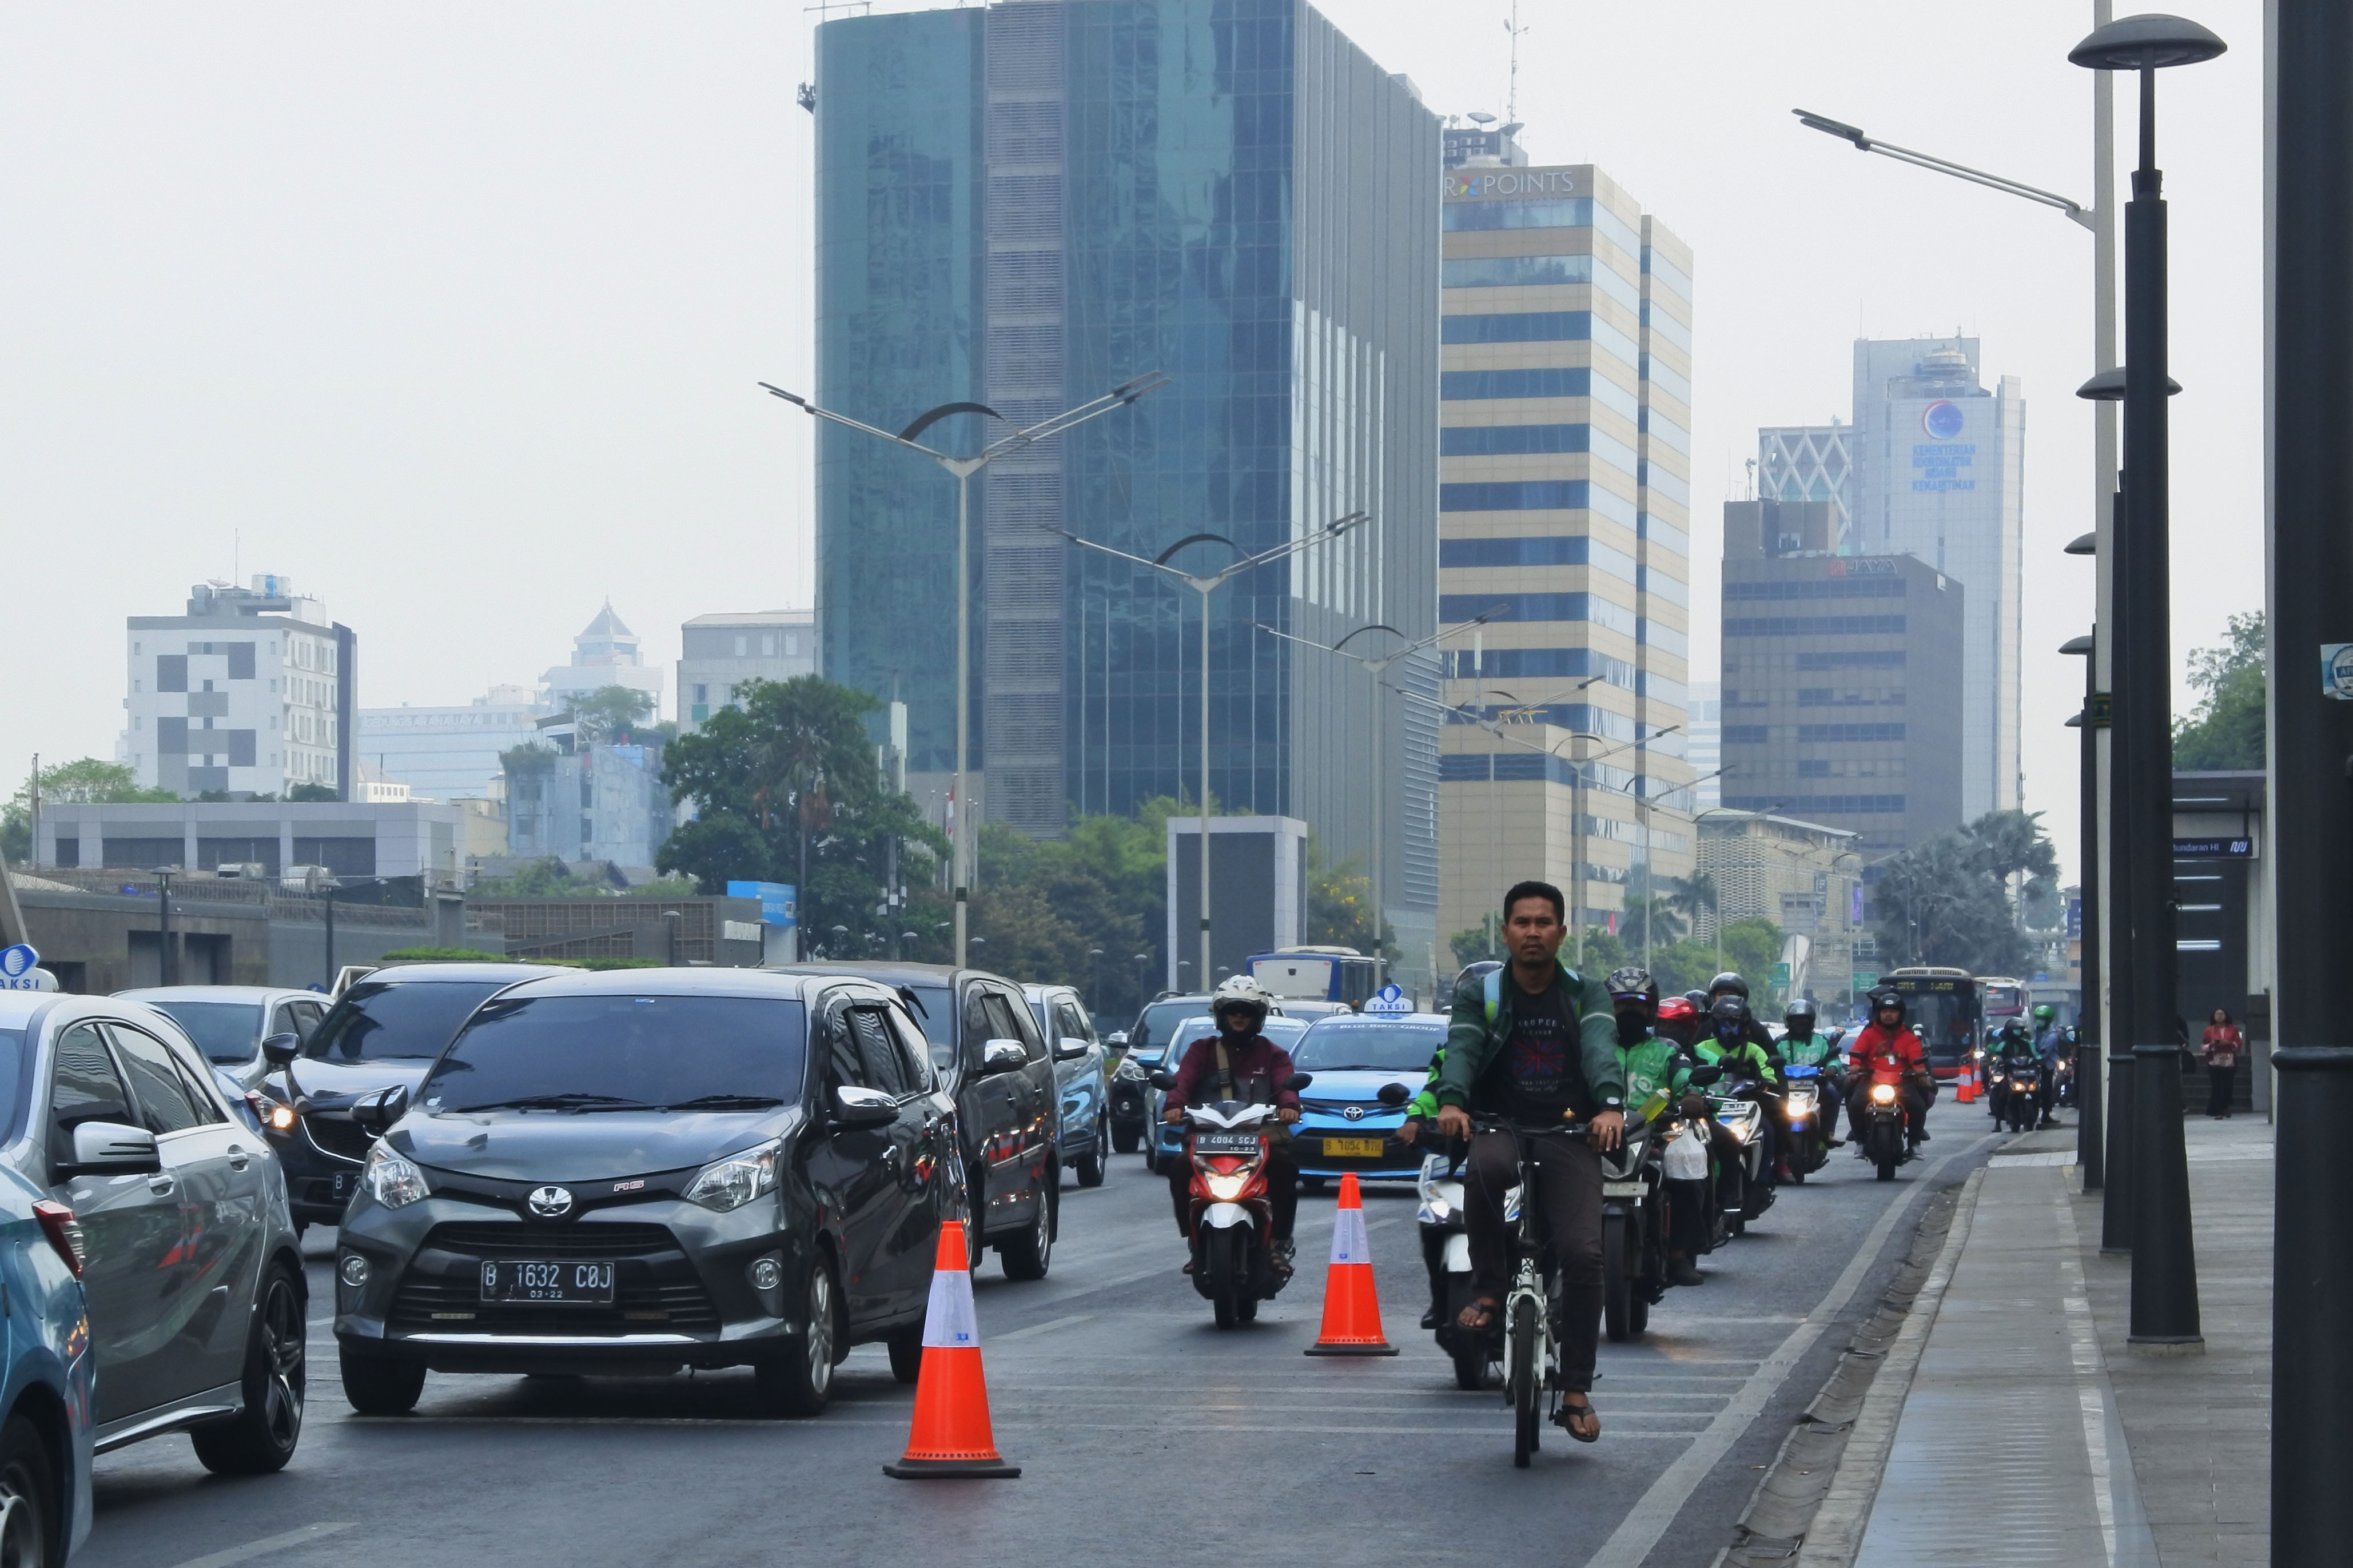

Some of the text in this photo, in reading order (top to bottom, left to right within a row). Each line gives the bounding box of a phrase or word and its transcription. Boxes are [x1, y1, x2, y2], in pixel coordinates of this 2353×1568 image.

[1483, 172, 1574, 194] POINTS
[1913, 445, 1976, 455] KEMENTERIAN
[1849, 559, 1898, 574] JAYA
[1401, 1023, 1440, 1031] GROUP
[336, 1175, 343, 1189] B
[614, 1180, 644, 1192] RS
[486, 1264, 497, 1286] B
[517, 1264, 560, 1287] 1632
